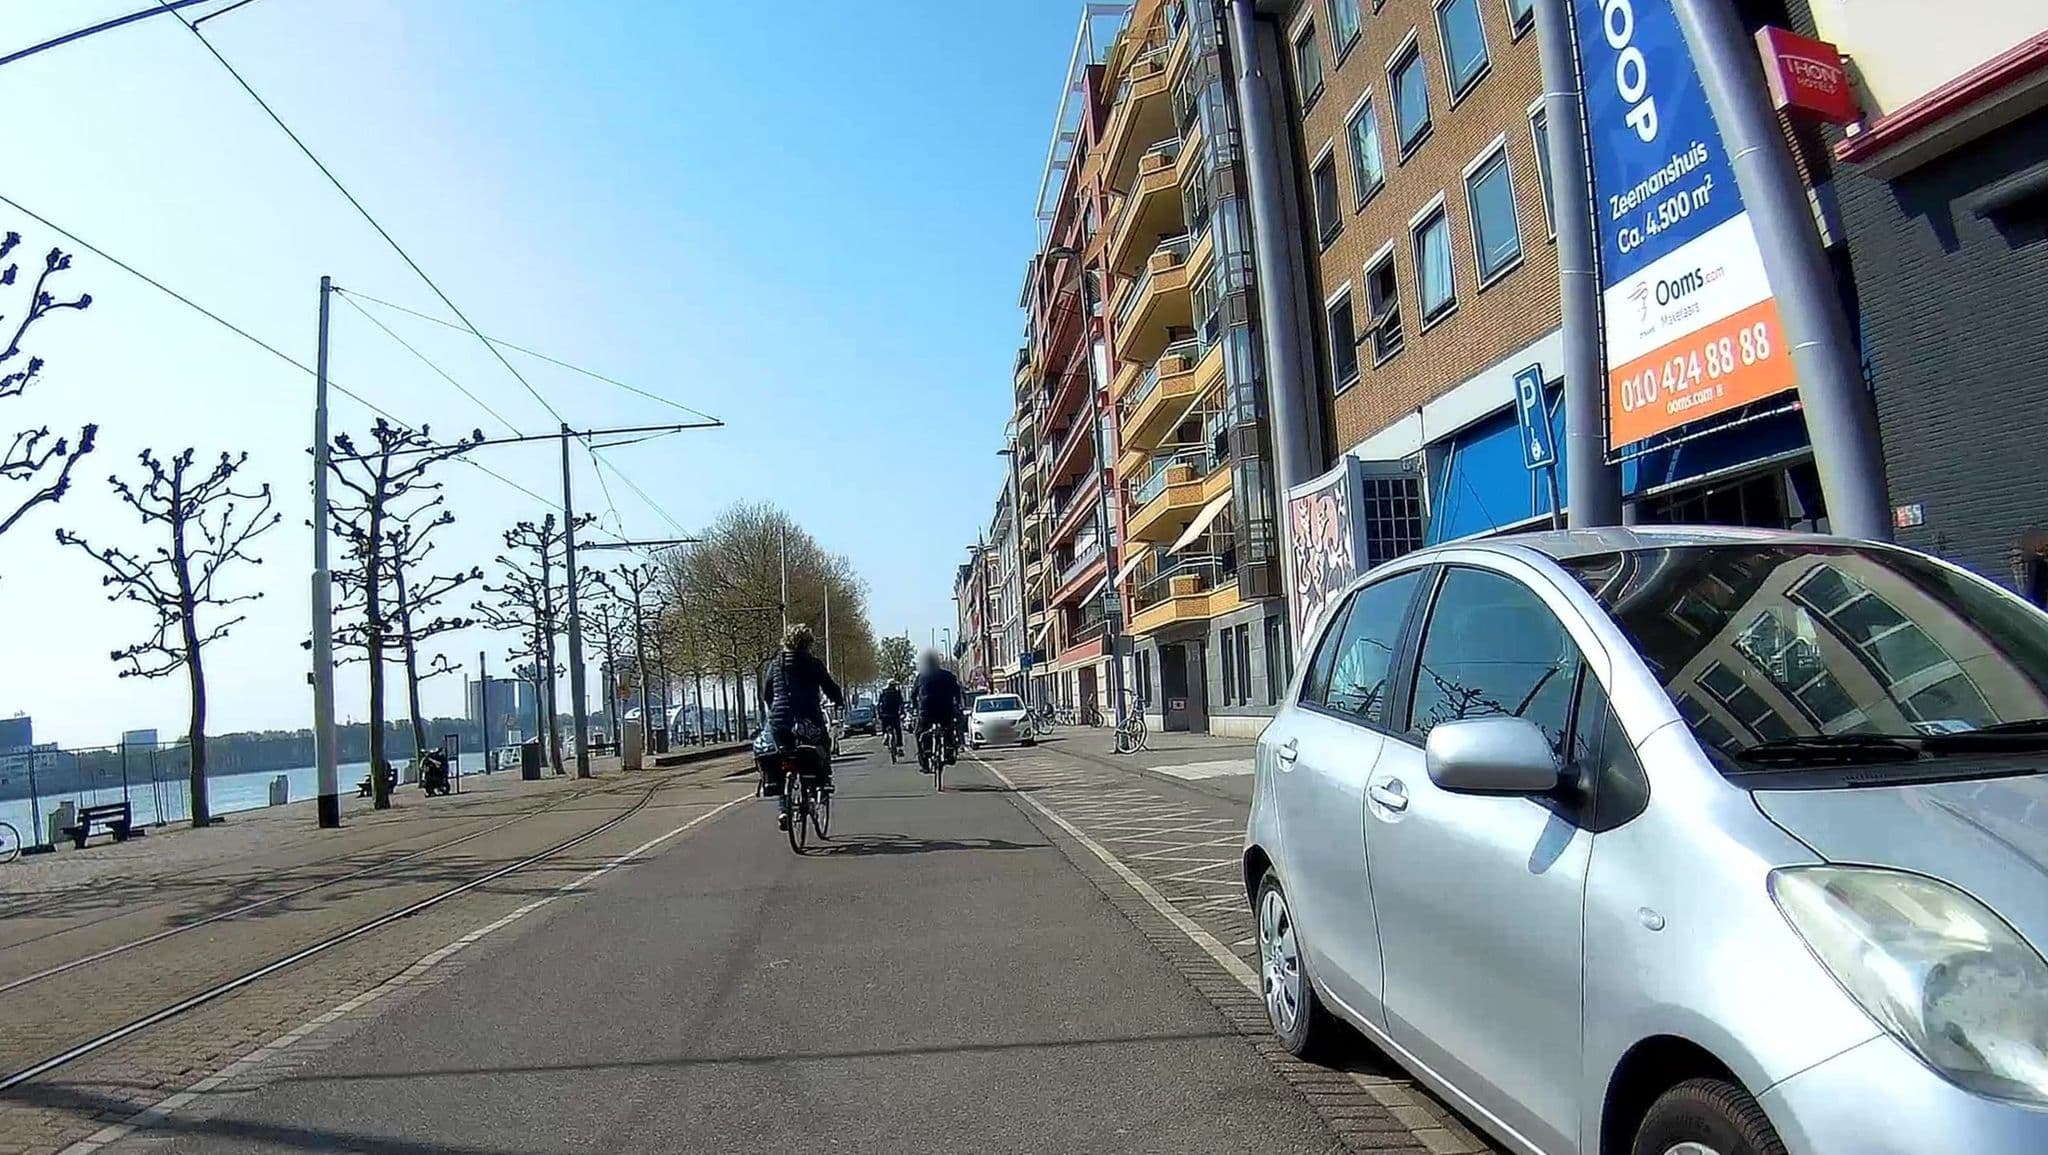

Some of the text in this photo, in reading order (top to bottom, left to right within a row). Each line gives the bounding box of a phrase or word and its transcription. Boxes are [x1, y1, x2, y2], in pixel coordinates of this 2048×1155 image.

[1598, 0, 1658, 142] OOP
[1779, 55, 1841, 84] THON
[1609, 141, 1708, 220] Zeemanshuis
[1618, 227, 1645, 253] Ca.
[1646, 191, 1690, 235] 4.500
[1519, 377, 1536, 427] P
[1621, 322, 1770, 412] 010 424 88 88
